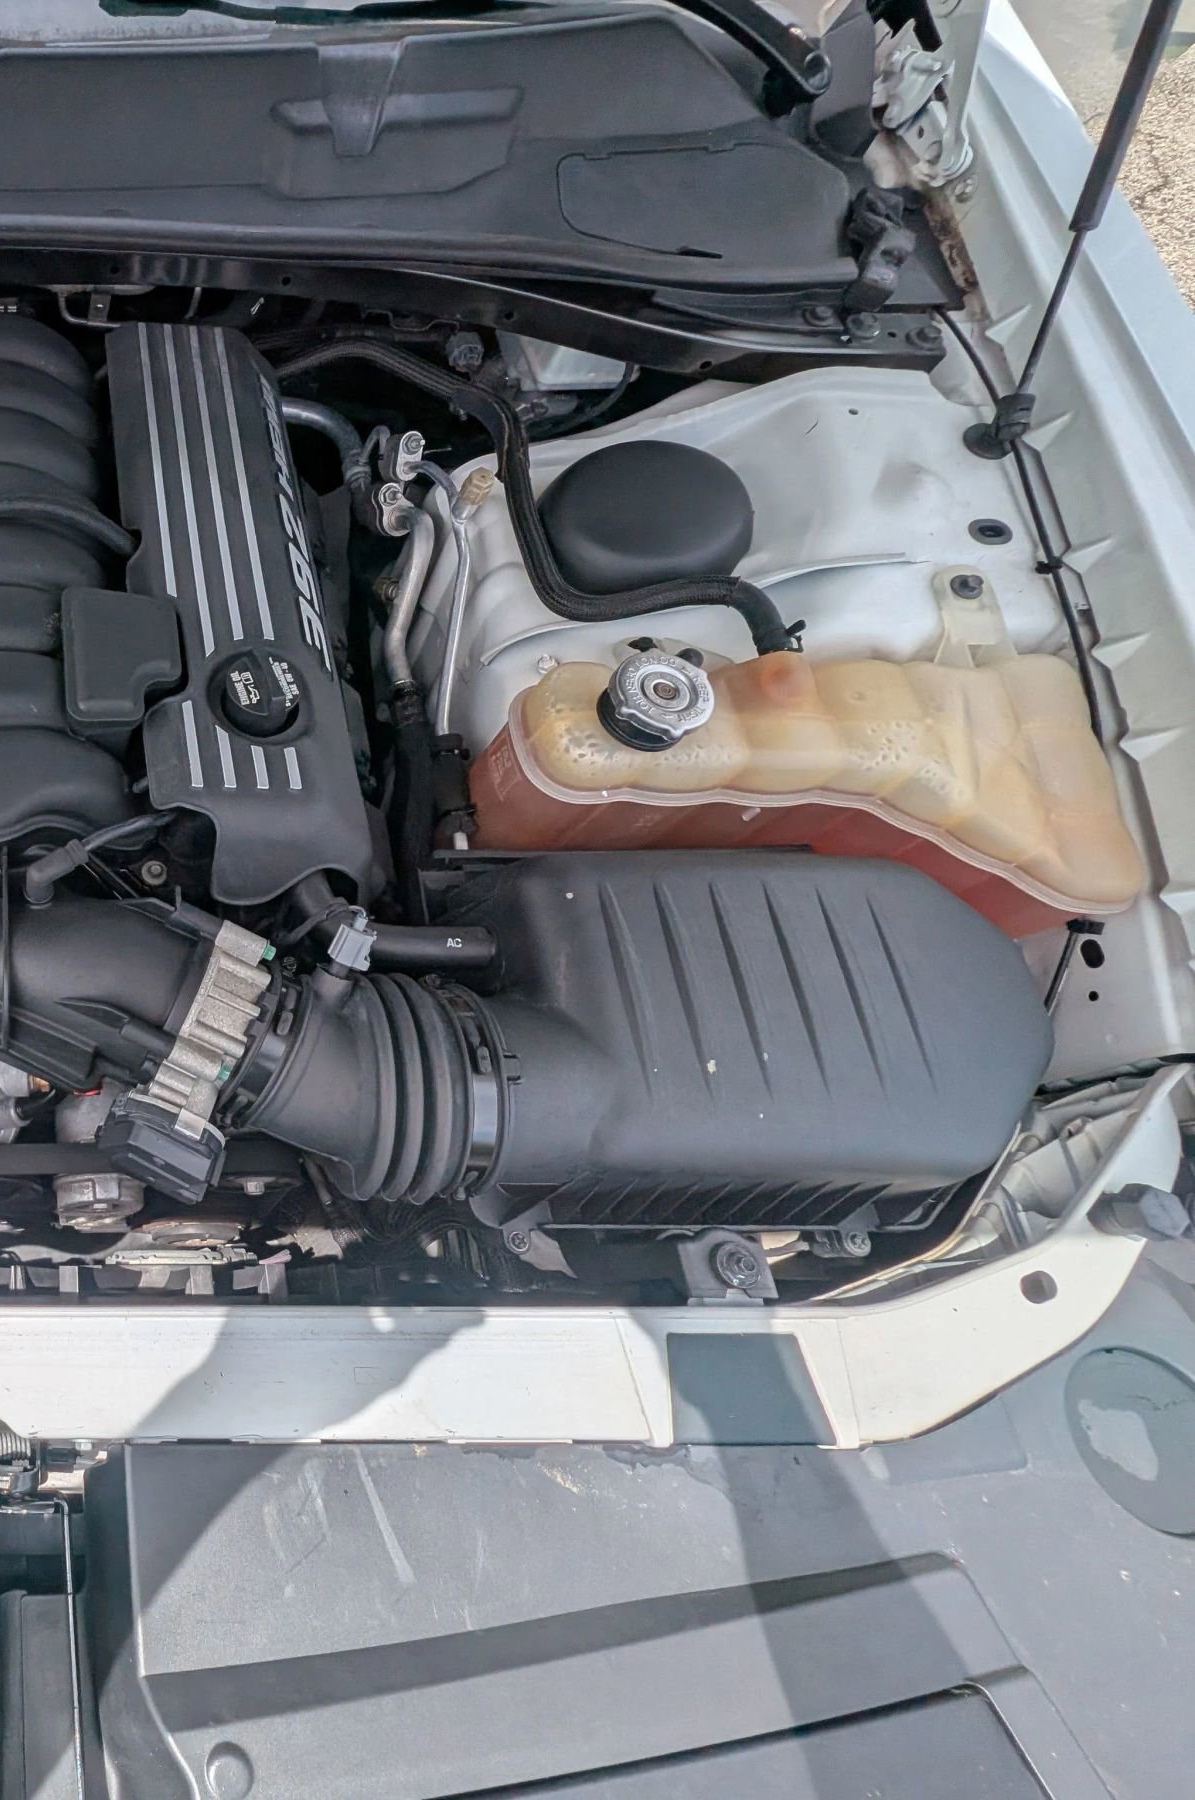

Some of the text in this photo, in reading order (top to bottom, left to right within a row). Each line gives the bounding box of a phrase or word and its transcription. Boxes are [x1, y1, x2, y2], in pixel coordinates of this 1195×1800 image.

[279, 492, 332, 673] 392
[230, 670, 250, 706] ENGINE OIL
[288, 683, 300, 696] SAE
[446, 937, 462, 948] AC
